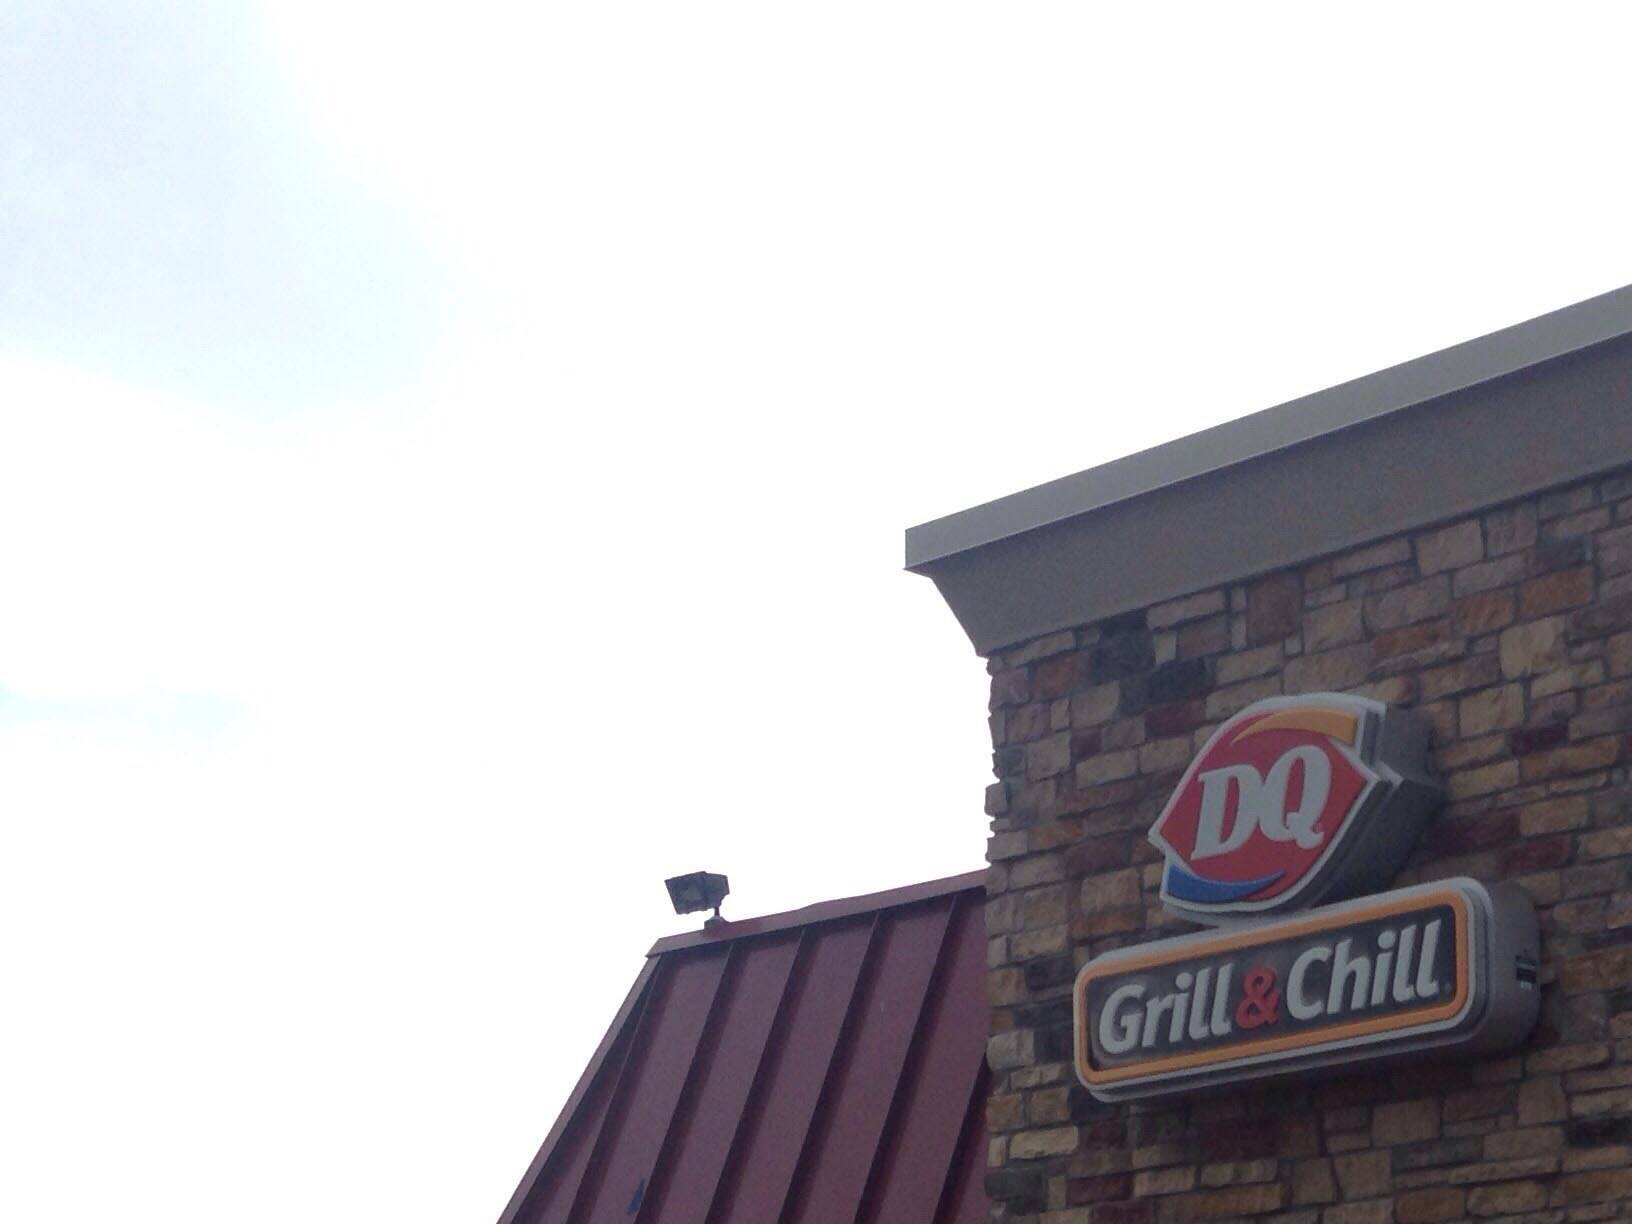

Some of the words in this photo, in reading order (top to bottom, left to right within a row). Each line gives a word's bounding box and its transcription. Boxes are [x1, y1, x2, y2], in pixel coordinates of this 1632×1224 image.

[1189, 744, 1332, 861] DQ
[1098, 962, 1235, 1055] Grill
[1235, 966, 1282, 1030] &
[1286, 919, 1443, 1021] Chill
